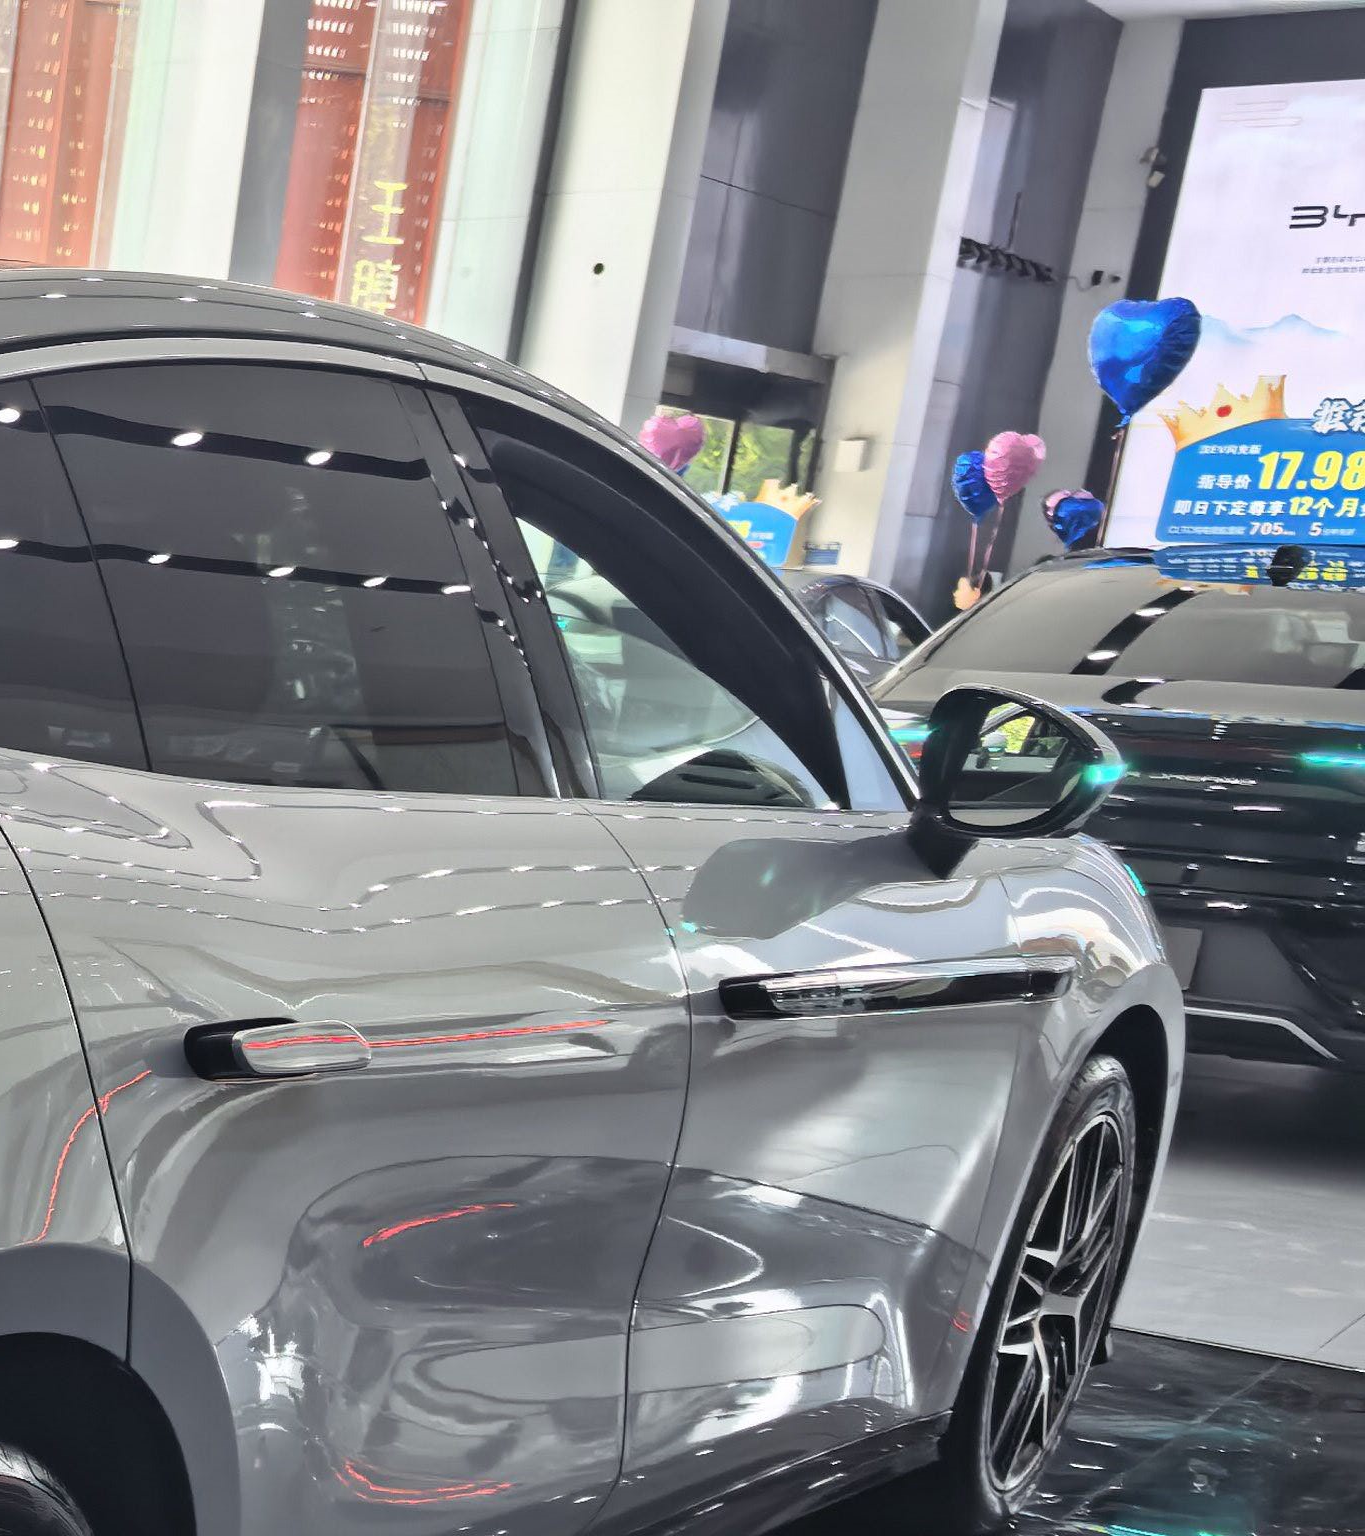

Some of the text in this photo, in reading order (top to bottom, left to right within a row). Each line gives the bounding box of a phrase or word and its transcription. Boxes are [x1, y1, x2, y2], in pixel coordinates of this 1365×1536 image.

[1289, 205, 1365, 229] BY
[1196, 450, 1365, 491] 指导价 17.98
[1172, 496, 1365, 518] 即日下定尊享12个月
